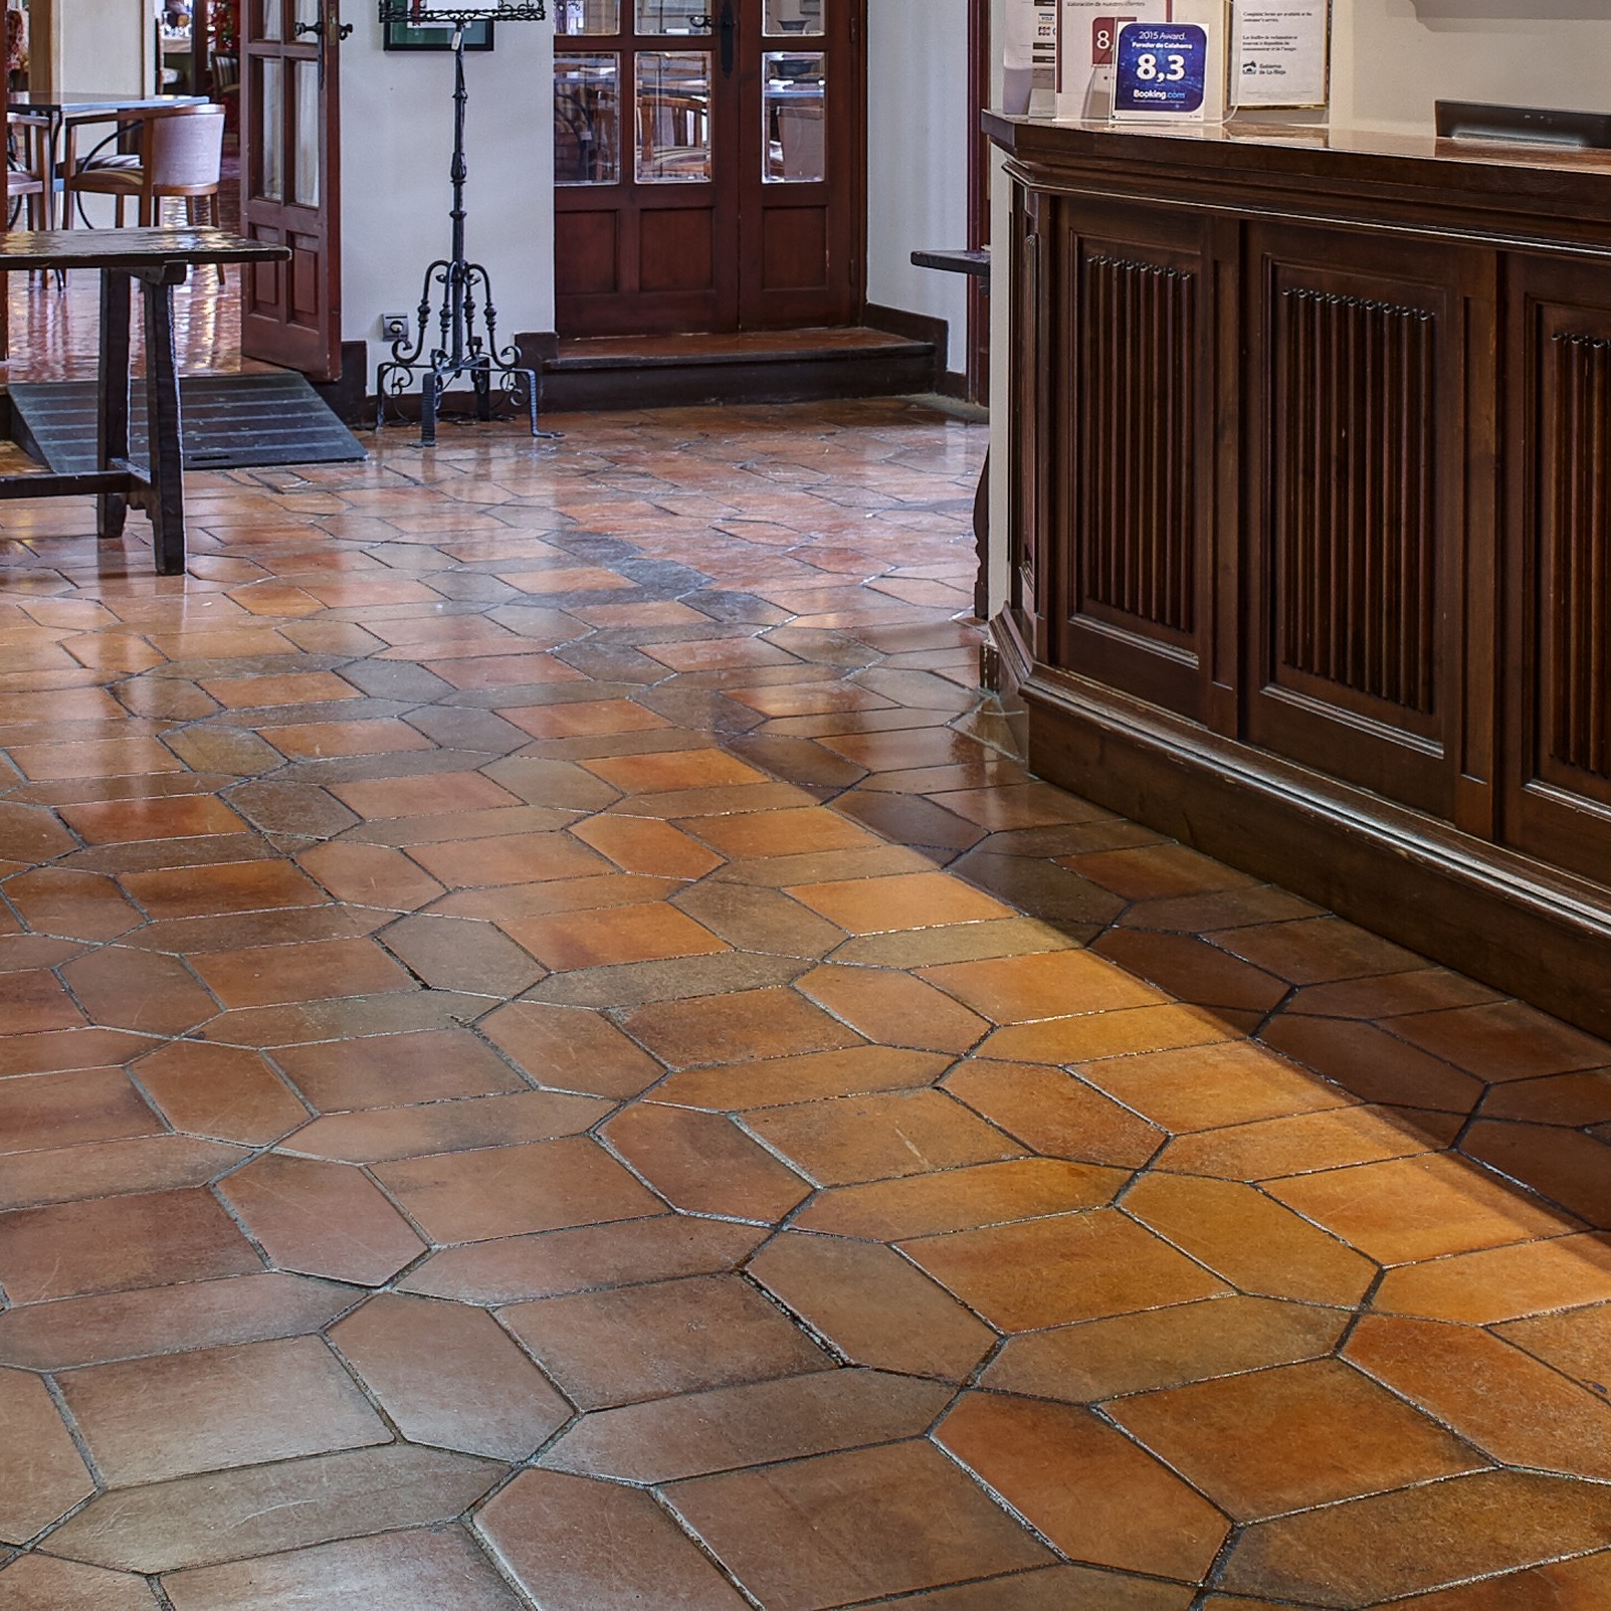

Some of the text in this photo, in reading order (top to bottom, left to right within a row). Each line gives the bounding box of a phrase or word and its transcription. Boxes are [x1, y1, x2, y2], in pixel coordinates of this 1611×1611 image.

[1138, 31, 1159, 40] 2015
[1136, 53, 1185, 82] 8,3
[1133, 89, 1186, 100] Booking.com
